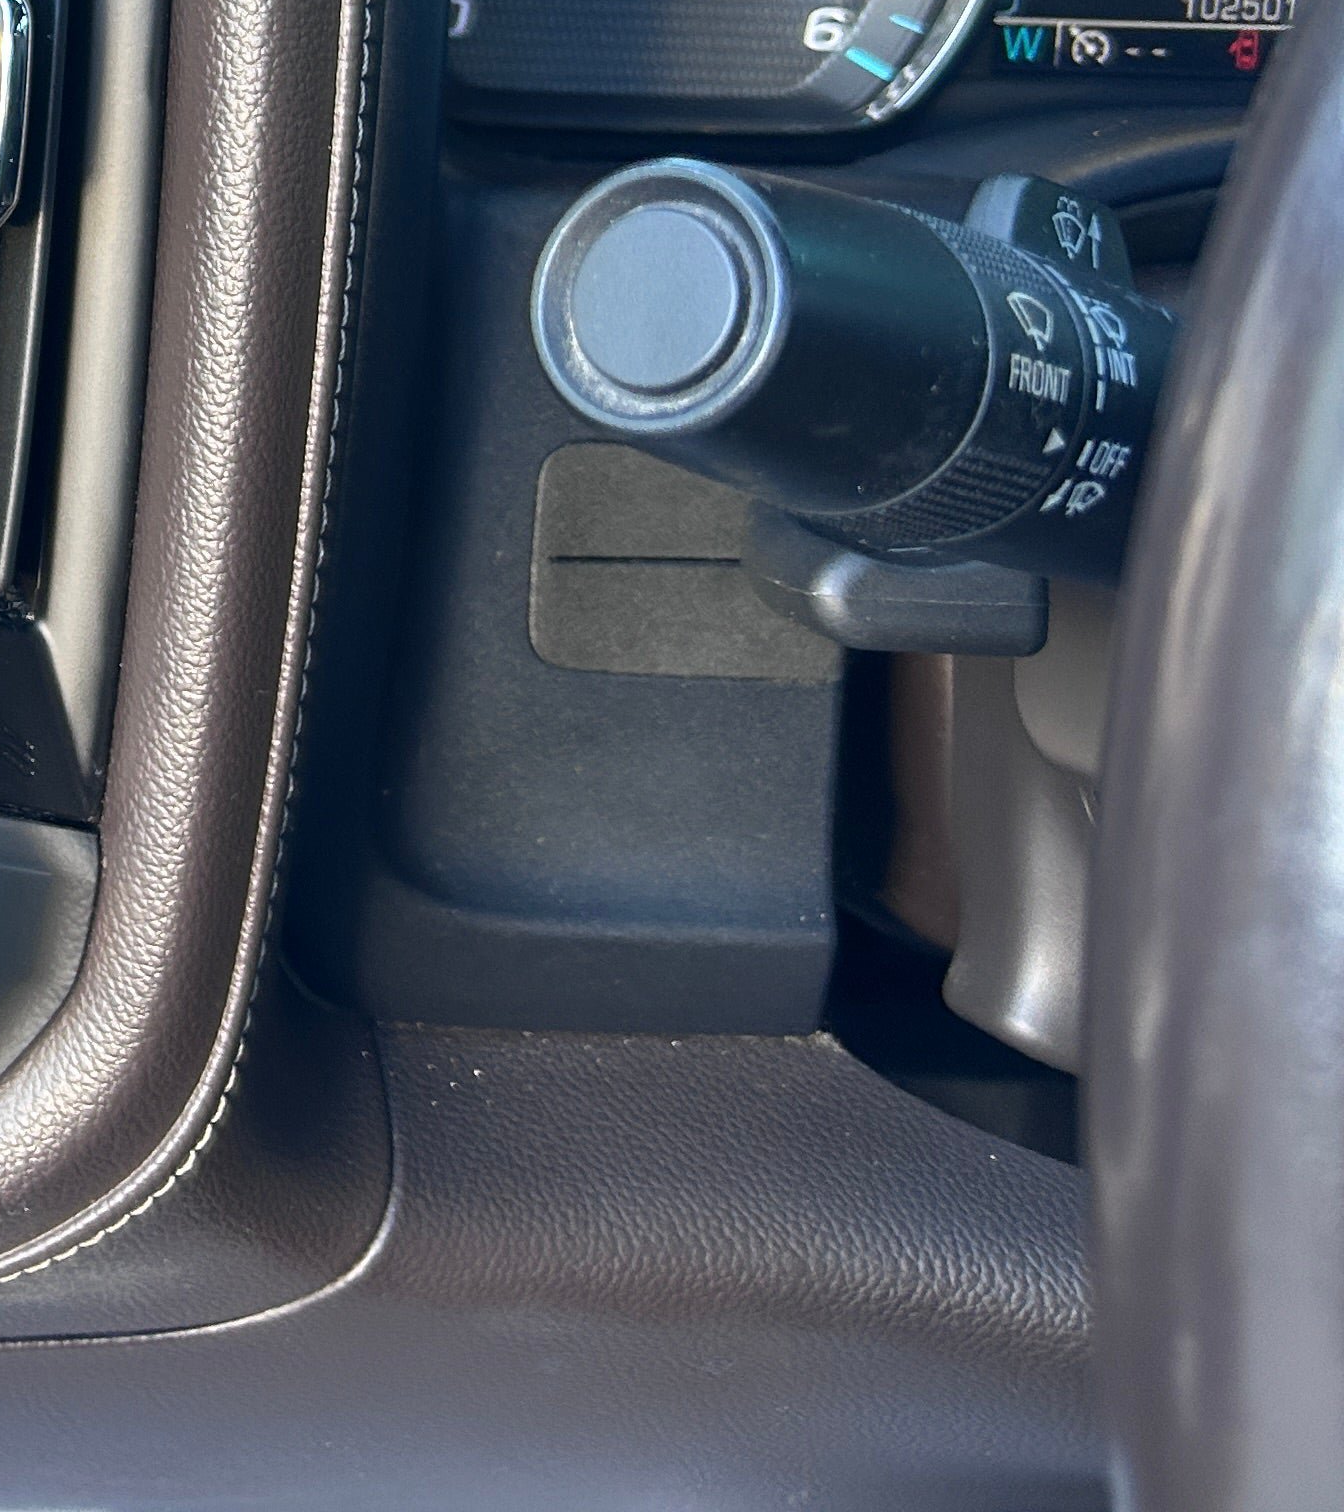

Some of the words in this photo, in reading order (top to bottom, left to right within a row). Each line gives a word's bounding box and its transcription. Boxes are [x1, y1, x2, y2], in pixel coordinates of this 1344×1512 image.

[803, 5, 856, 52] 6
[1003, 25, 1045, 63] W
[1008, 352, 1073, 407] FRONT
[1106, 346, 1138, 388] INT
[1088, 439, 1133, 480] OFF
